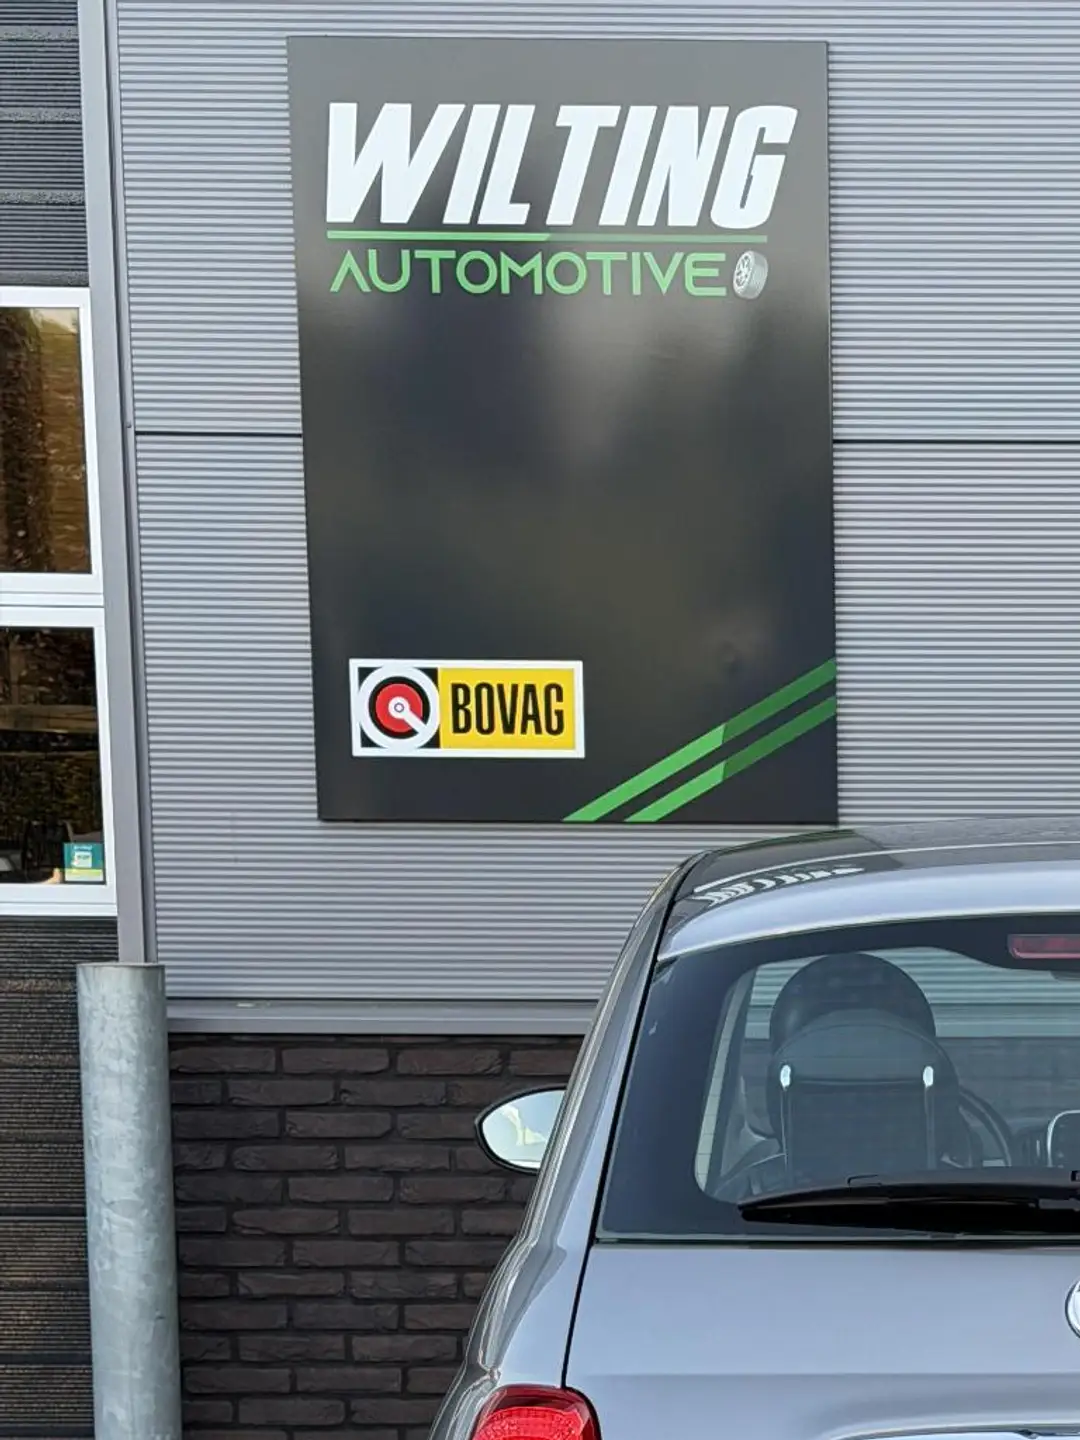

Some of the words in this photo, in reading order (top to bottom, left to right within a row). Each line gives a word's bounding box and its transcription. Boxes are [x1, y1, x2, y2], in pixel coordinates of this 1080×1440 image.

[326, 102, 798, 229] WILTING
[329, 249, 727, 296] AUTOMOTIVE
[451, 682, 564, 736] BOVAG
